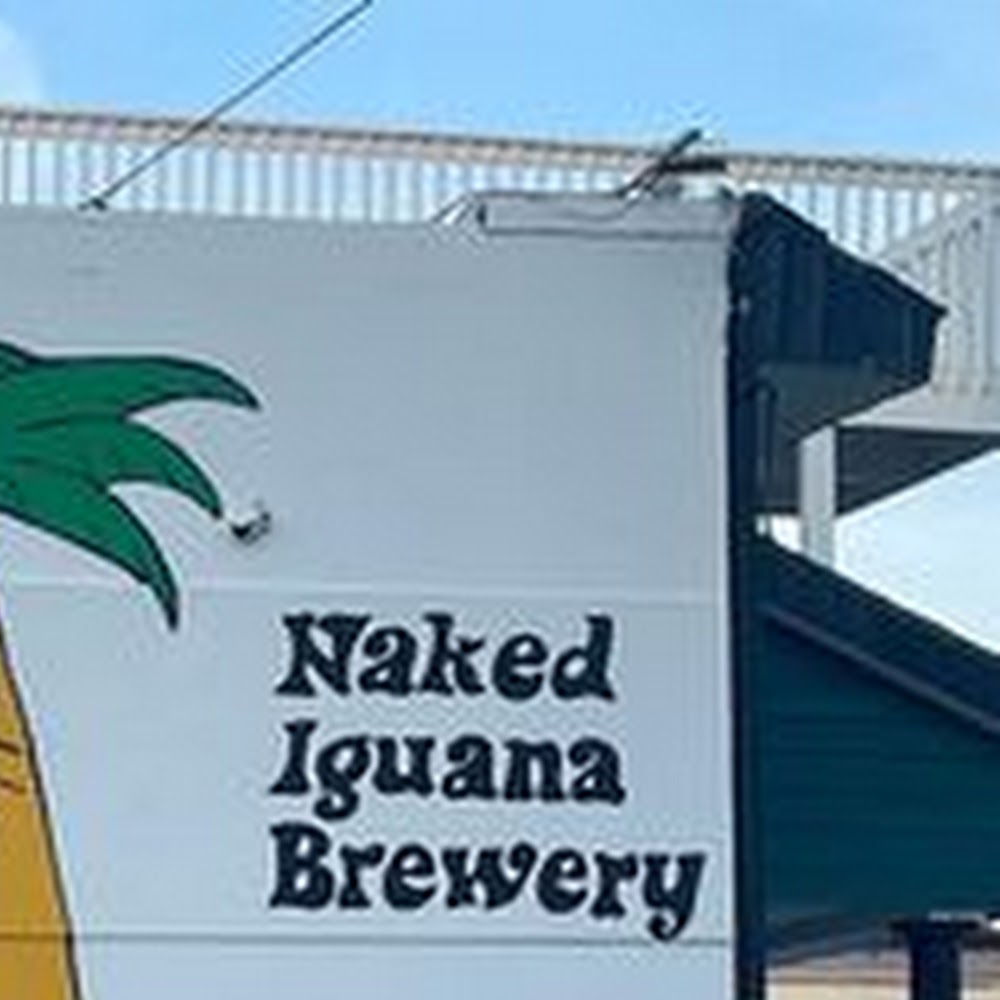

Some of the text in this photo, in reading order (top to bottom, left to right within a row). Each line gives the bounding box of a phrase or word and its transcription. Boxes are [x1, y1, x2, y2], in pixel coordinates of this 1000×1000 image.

[275, 612, 616, 702] Naked
[268, 719, 627, 821] Iguana
[268, 822, 706, 942] Brewery
